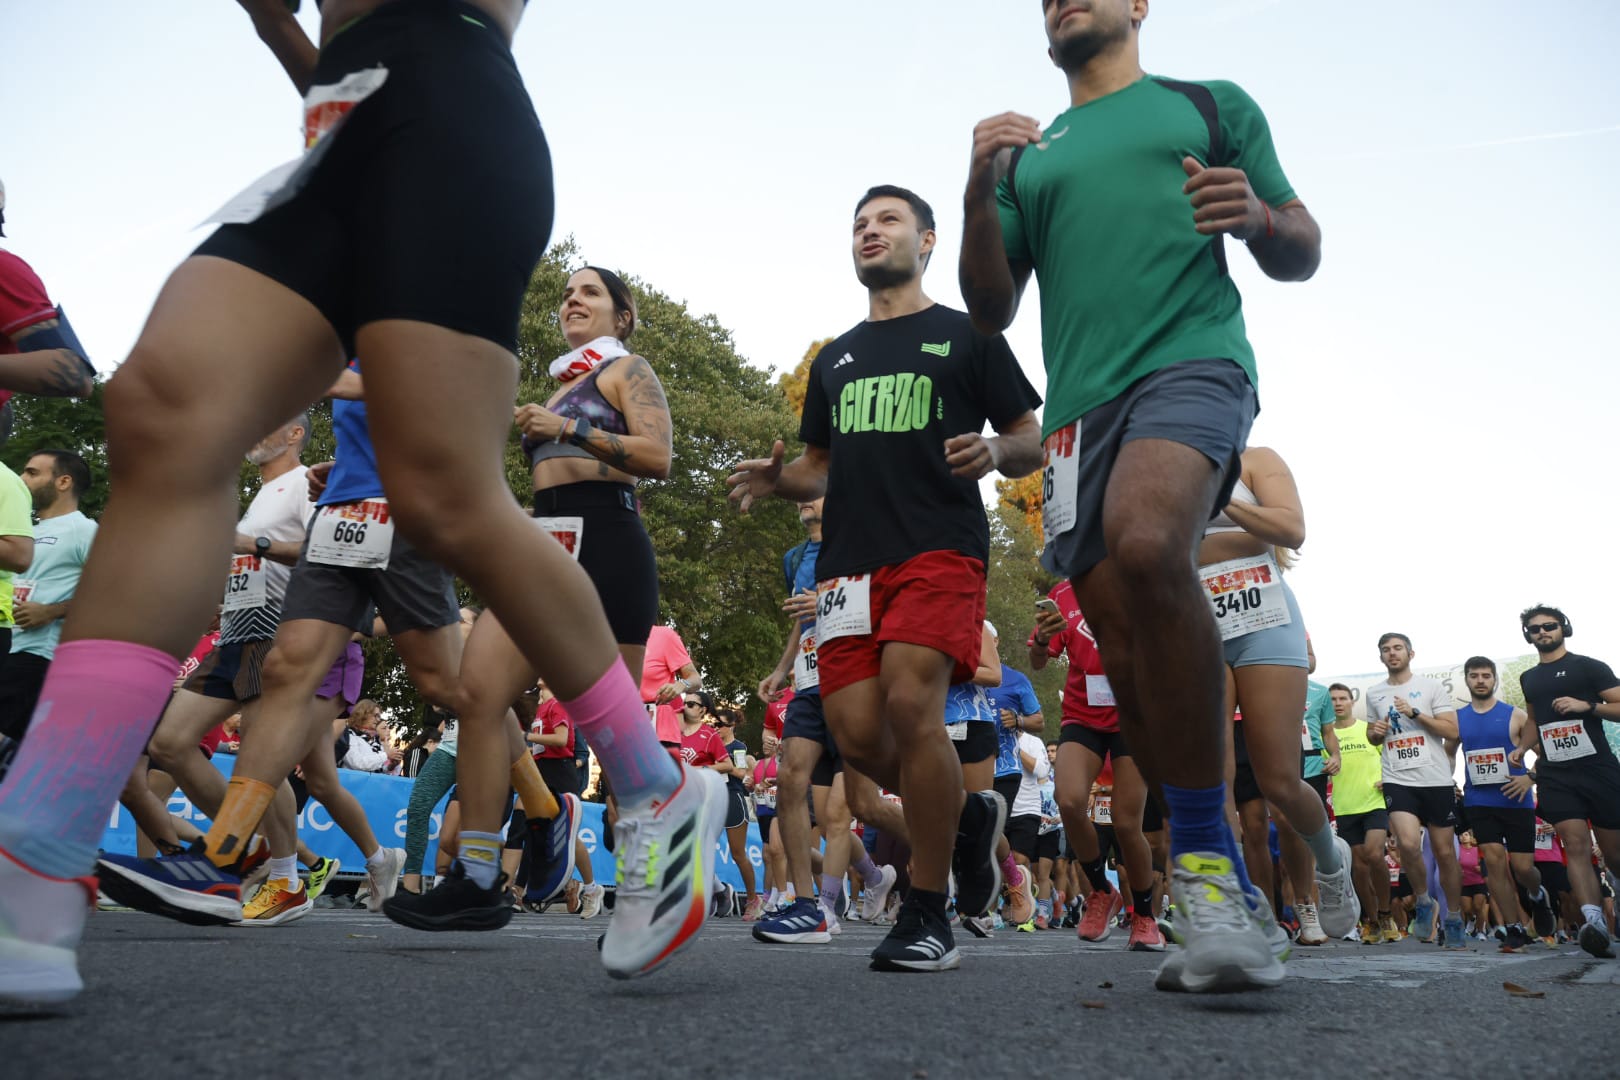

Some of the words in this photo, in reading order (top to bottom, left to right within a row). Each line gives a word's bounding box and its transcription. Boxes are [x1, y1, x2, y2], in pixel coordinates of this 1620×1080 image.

[840, 372, 932, 434] CIERZO
[333, 520, 368, 545] 666
[1212, 586, 1262, 618] 3410
[1397, 746, 1420, 760] 1696
[1553, 736, 1579, 751] 1450
[1476, 764, 1498, 775] 1575
